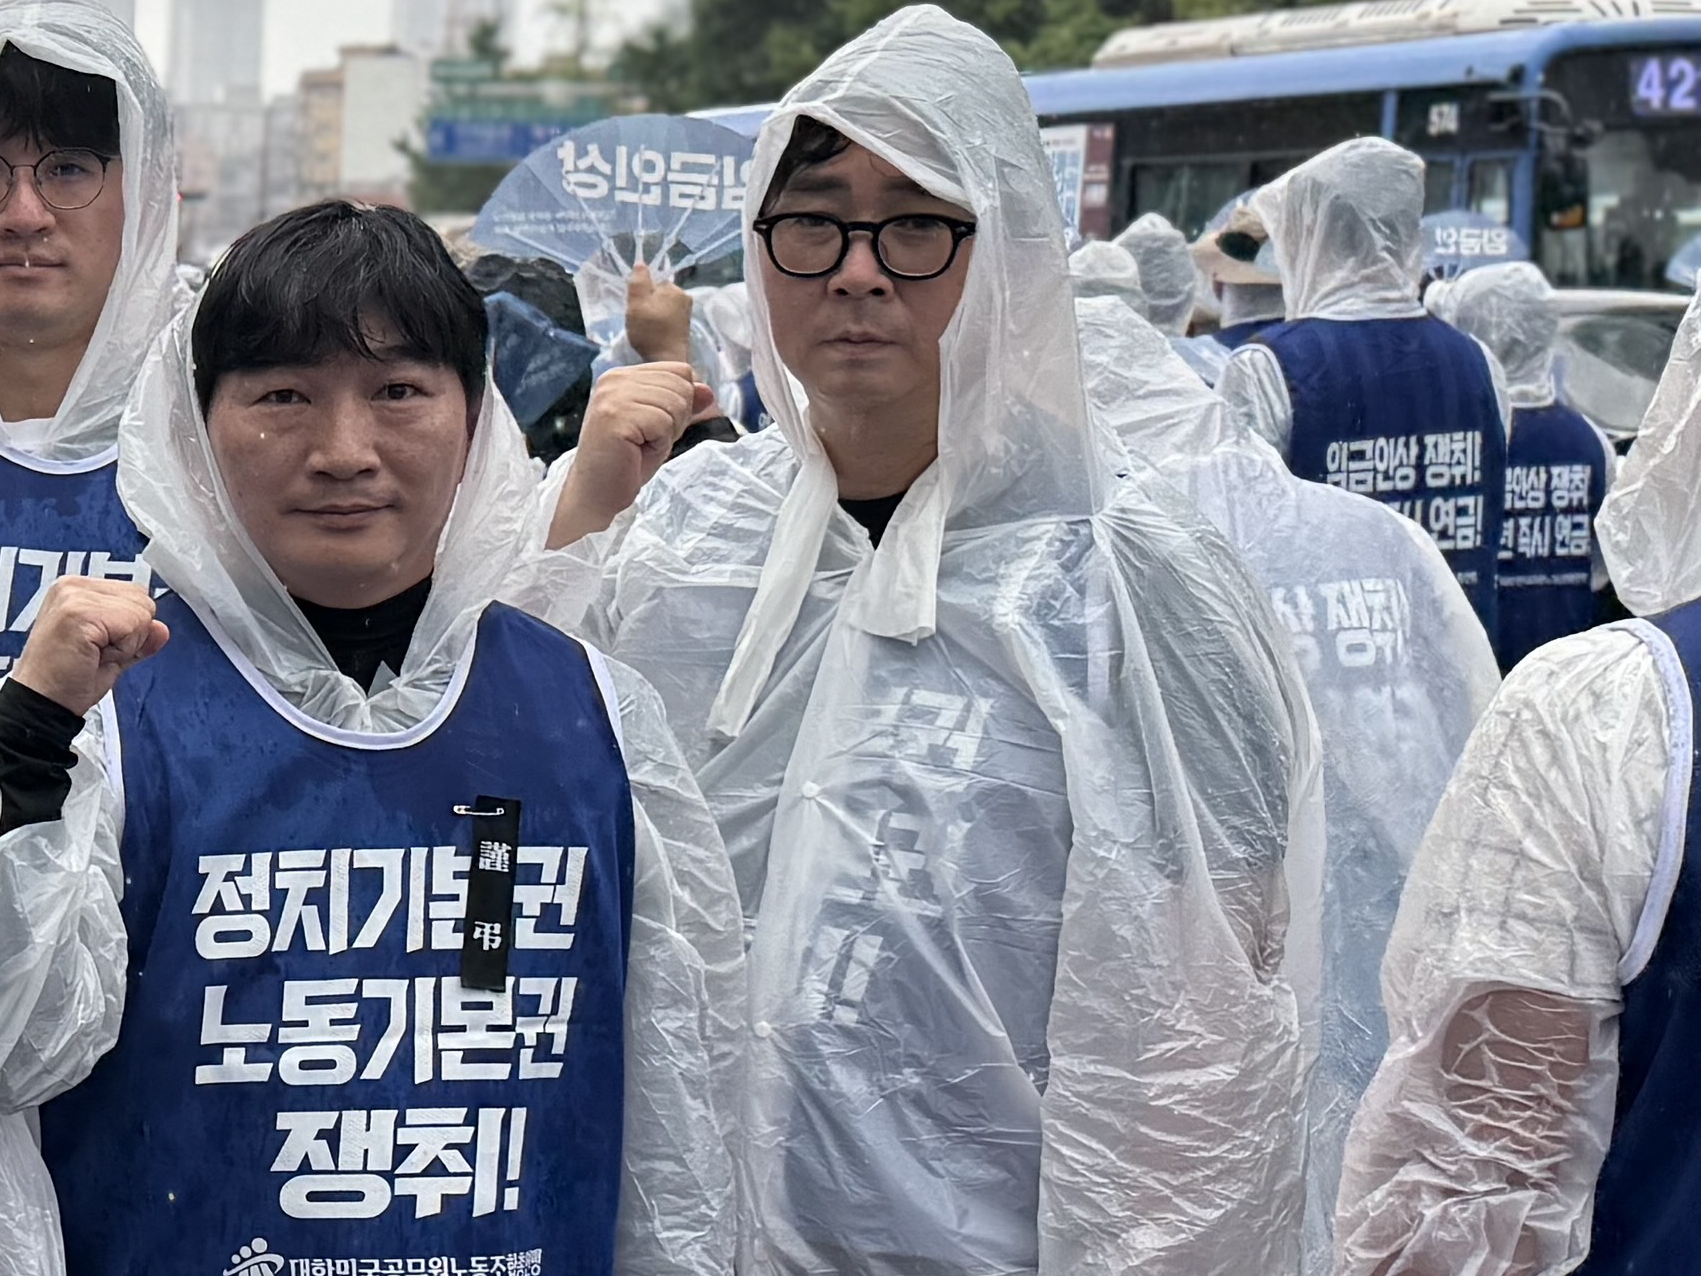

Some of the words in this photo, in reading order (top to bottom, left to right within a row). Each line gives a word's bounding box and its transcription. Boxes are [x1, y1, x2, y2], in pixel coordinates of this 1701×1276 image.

[1423, 430, 1482, 489] 쟁취!
[195, 976, 578, 1085] 노동기본권
[270, 1107, 528, 1220] 쟁취!
